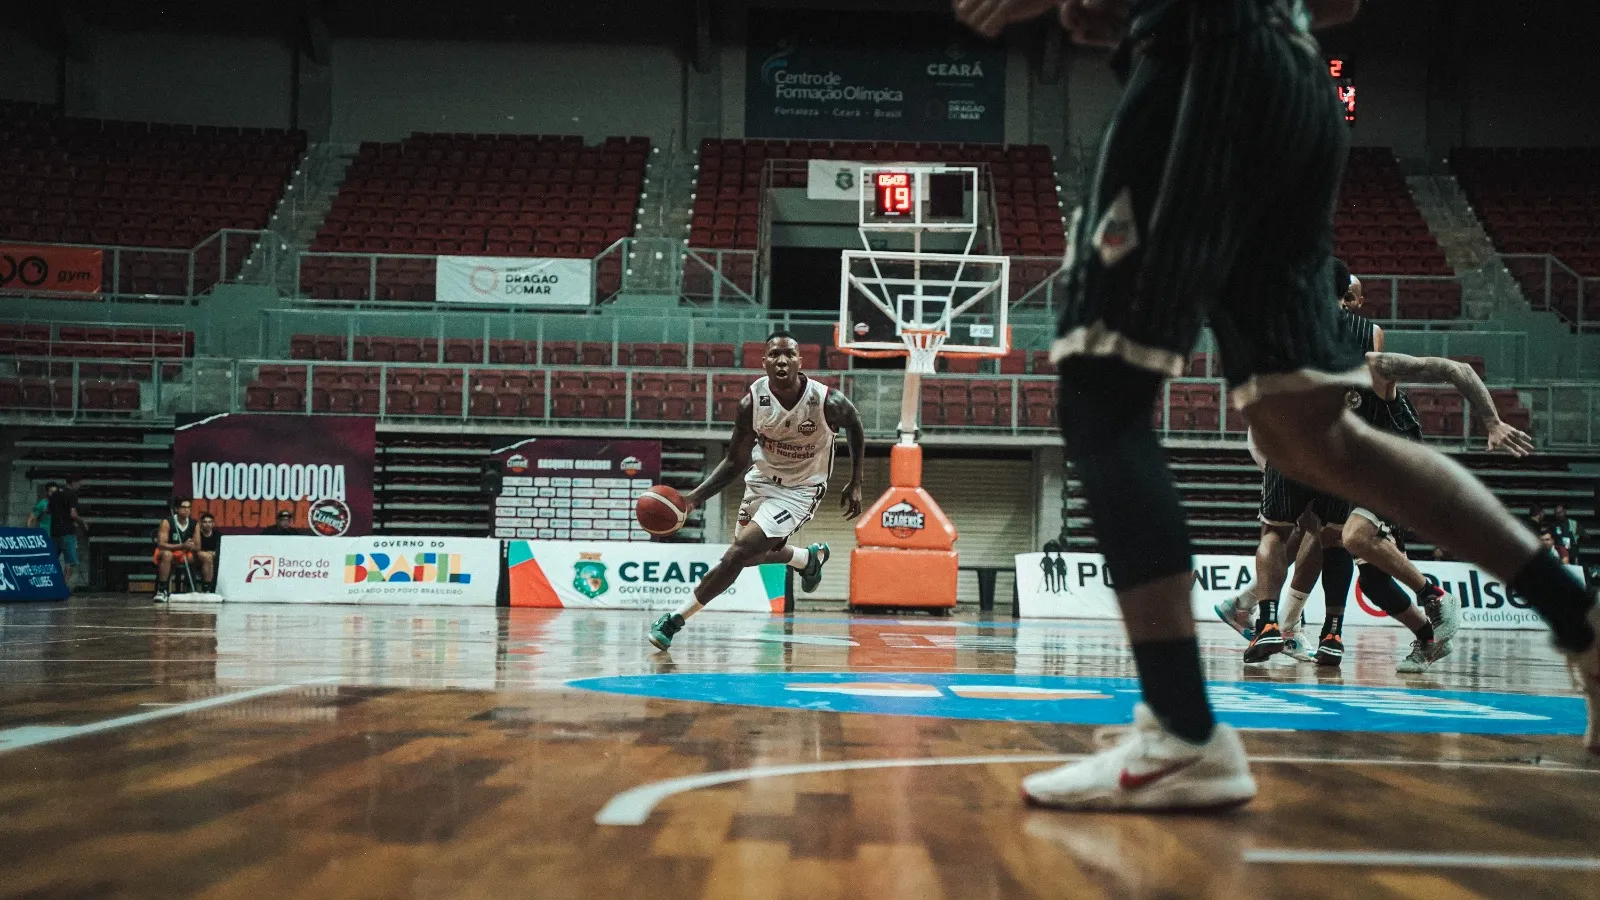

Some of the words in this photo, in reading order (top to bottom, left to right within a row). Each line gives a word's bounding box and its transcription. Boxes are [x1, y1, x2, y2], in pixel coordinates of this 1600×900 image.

[926, 61, 984, 77] CEARÁ
[774, 70, 822, 85] Centro
[823, 71, 841, 85] de
[775, 84, 843, 102] Formação
[843, 85, 903, 103] Olímpica
[885, 187, 909, 209] 19
[58, 270, 91, 283] gym
[17, 535, 48, 549] ATLETAS
[278, 557, 314, 568] Banco
[315, 559, 330, 568] do
[344, 552, 471, 584] BRASIL
[277, 569, 329, 579] Nordeste
[618, 561, 710, 583] CEAR
[619, 586, 671, 595] GOVERNO
[674, 586, 691, 595] DO
